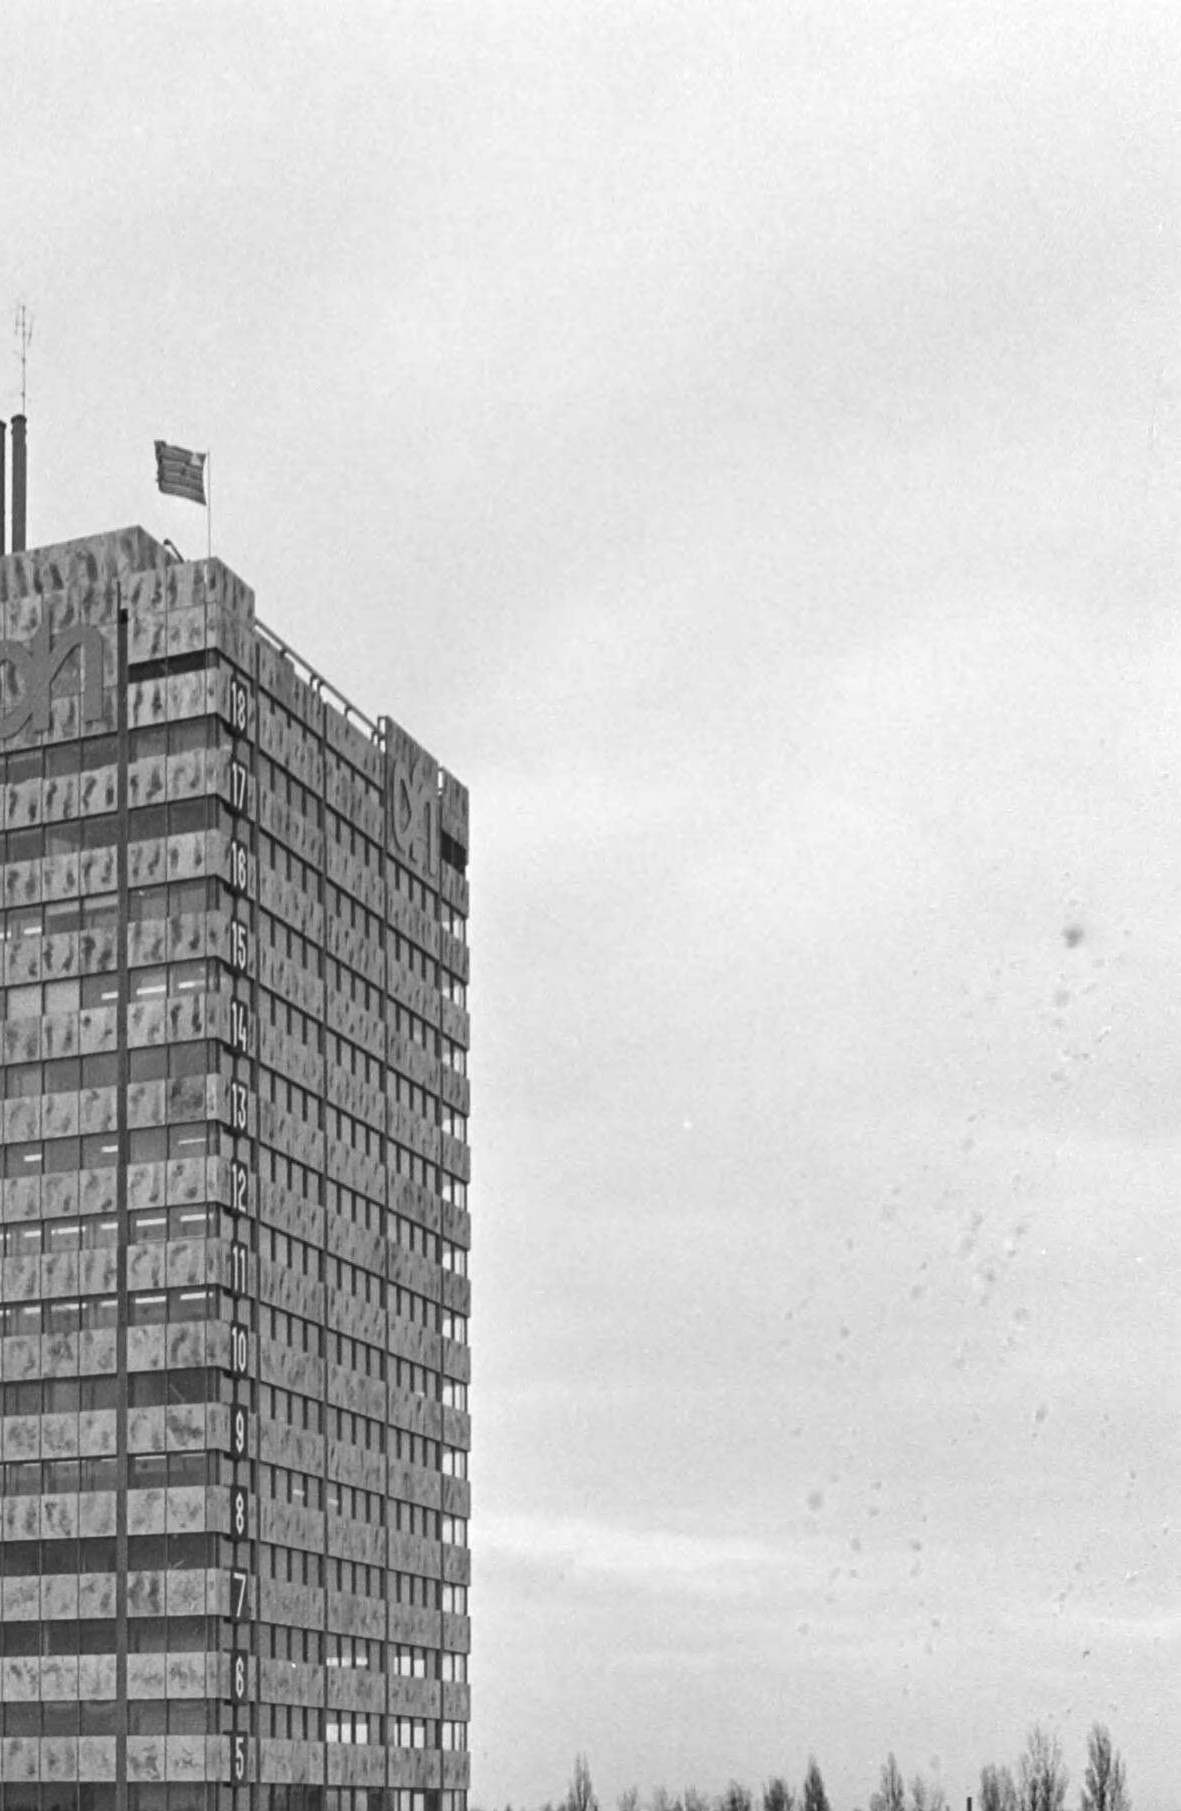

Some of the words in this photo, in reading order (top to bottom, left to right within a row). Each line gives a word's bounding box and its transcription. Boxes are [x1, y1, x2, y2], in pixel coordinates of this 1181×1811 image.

[231, 681, 246, 731] 18
[232, 761, 247, 811] 17
[231, 840, 247, 891] 16
[231, 920, 247, 970] 15
[231, 1001, 247, 1052] 14
[231, 1081, 247, 1129] 13
[232, 1163, 247, 1213] 12
[233, 1245, 246, 1294] 11
[232, 1325, 247, 1373] 10
[235, 1410, 244, 1453] 9
[235, 1491, 244, 1535] 8
[233, 1571, 247, 1617] 7
[235, 1655, 245, 1698] 6
[235, 1736, 244, 1780] 5
